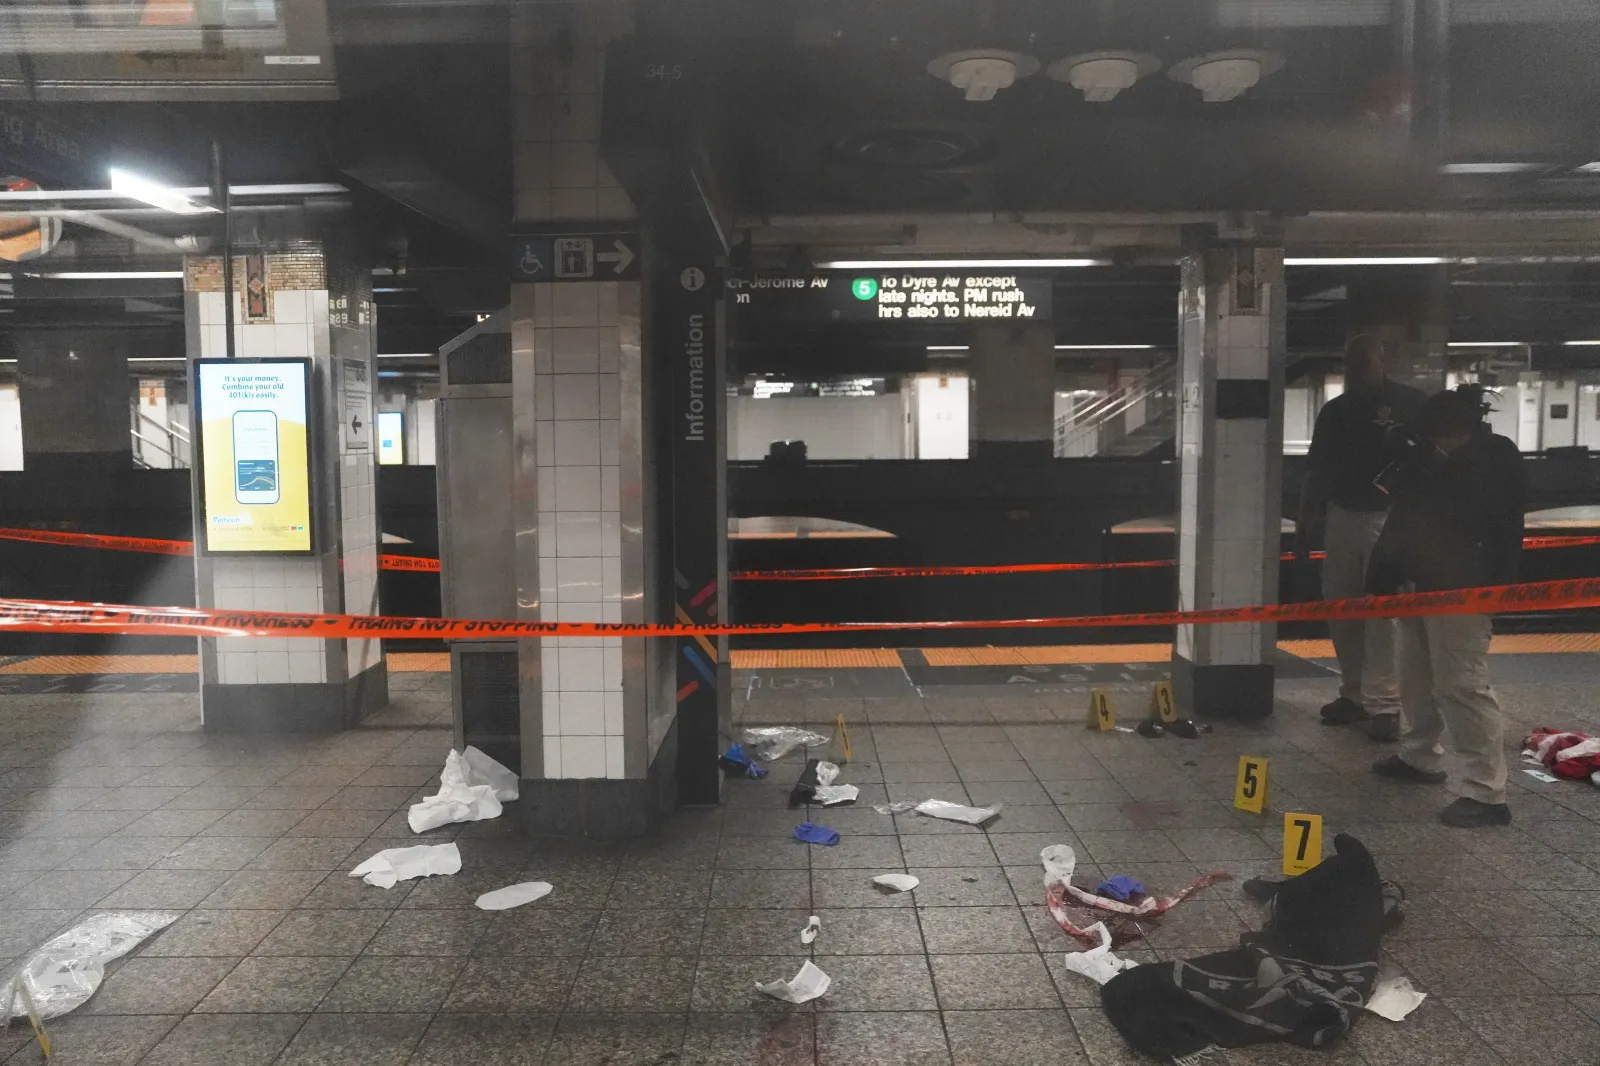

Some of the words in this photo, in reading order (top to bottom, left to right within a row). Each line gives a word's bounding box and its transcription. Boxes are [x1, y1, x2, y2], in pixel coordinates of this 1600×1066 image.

[810, 276, 829, 288] Av
[859, 281, 870, 296] 5
[881, 275, 898, 288] To
[901, 274, 937, 290] Dyre
[942, 276, 960, 288] Av
[965, 276, 1017, 290] except
[878, 289, 907, 303] late
[911, 289, 959, 305] nights.
[964, 288, 988, 302] PM
[992, 288, 1024, 302] rush
[878, 303, 903, 318] hrs
[907, 304, 939, 317] also
[944, 304, 960, 317] to
[964, 303, 1012, 317] Nereid
[1017, 303, 1036, 317] Av
[238, 376, 253, 384] your
[255, 376, 282, 384] money.
[685, 314, 706, 441] Information
[222, 383, 253, 391] Combine
[255, 384, 271, 392] your
[256, 392, 279, 400] easily.
[213, 516, 241, 524] Pension
[420, 619, 461, 631] NOT
[1100, 695, 1109, 721] 4
[1161, 687, 1171, 716] 3
[1243, 762, 1258, 799] 5
[1294, 819, 1311, 861] 7
